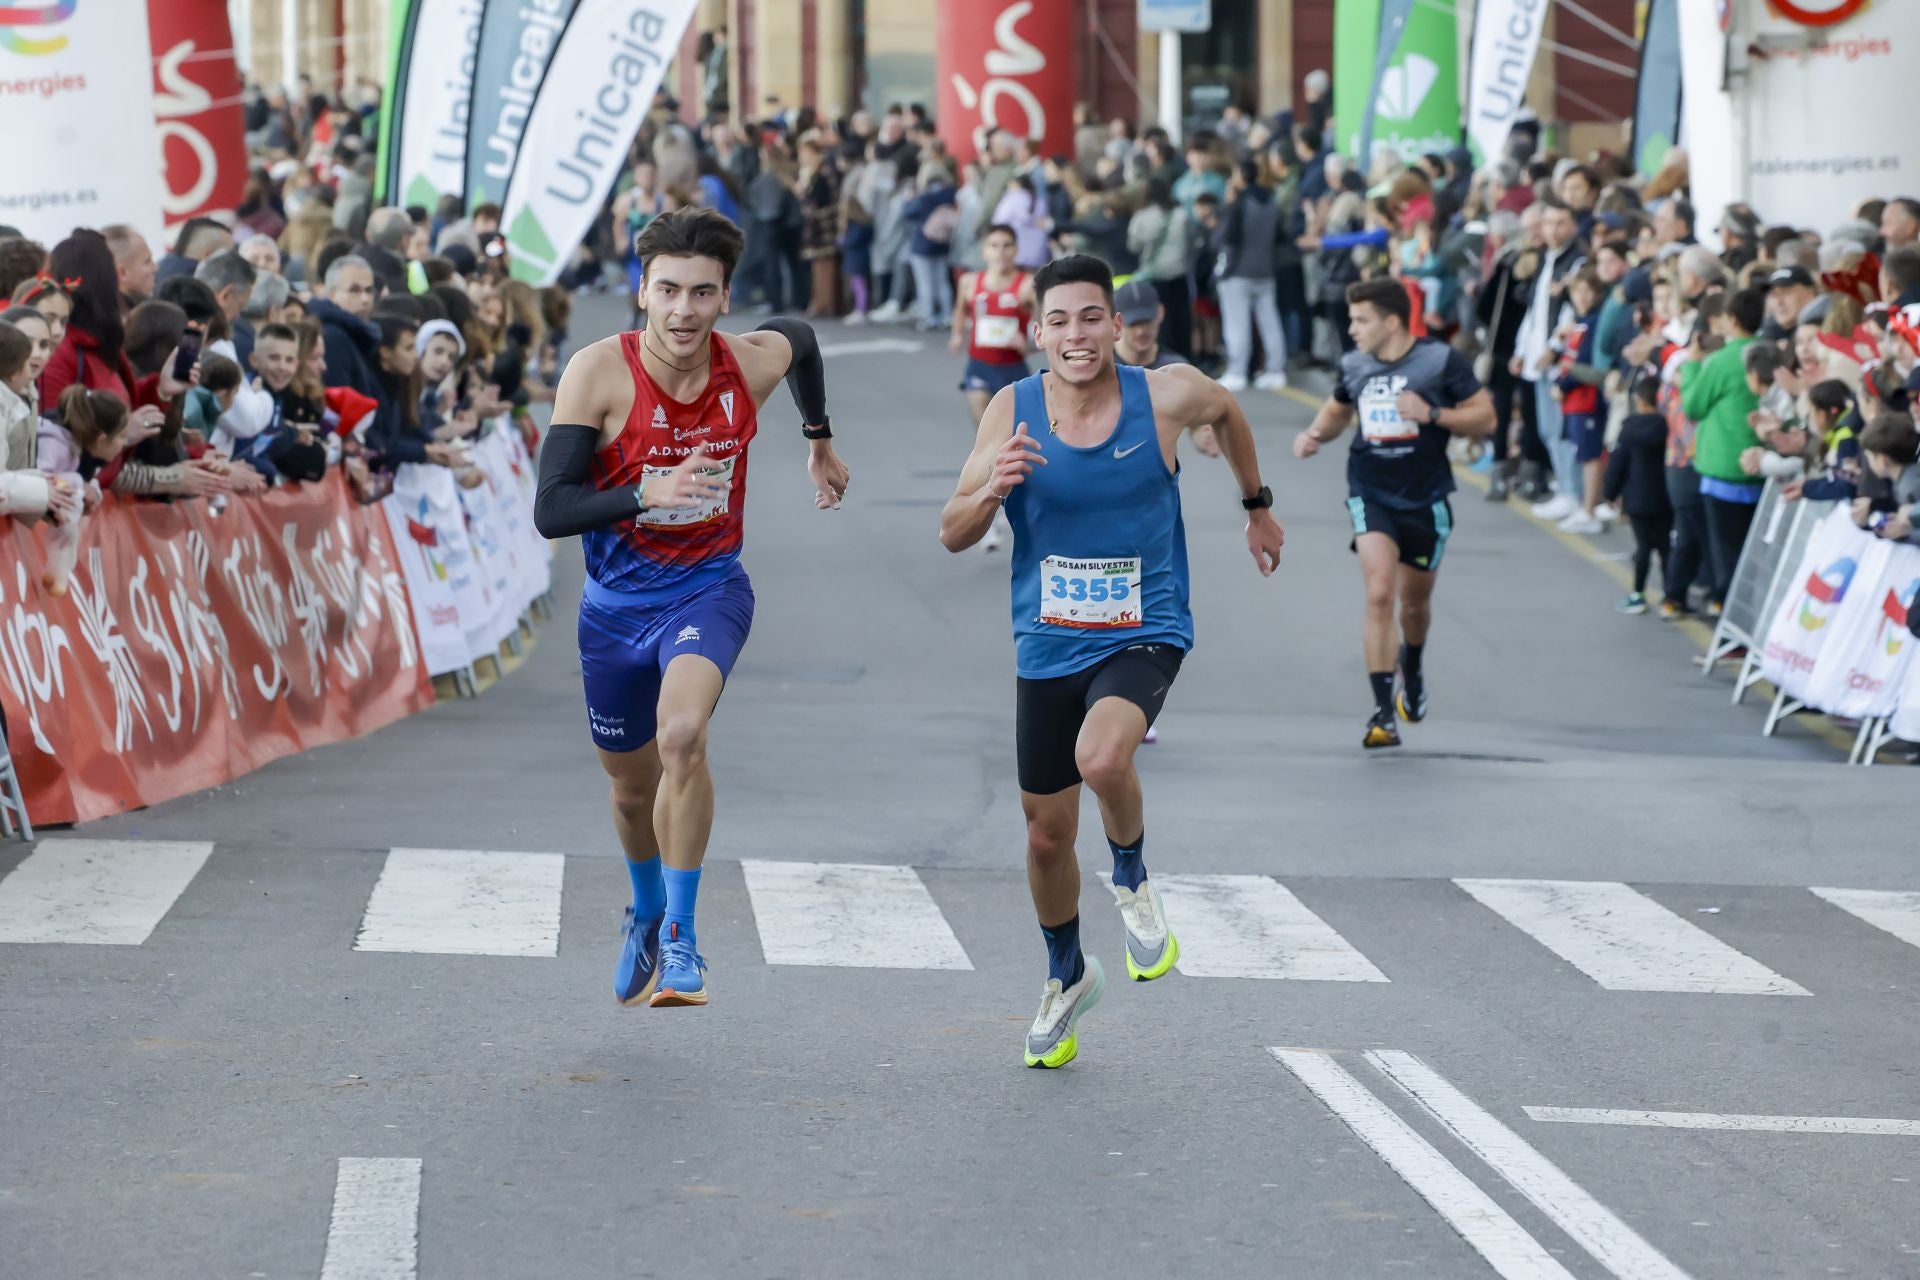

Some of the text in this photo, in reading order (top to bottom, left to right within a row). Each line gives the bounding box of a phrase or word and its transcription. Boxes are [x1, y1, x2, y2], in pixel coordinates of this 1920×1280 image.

[546, 9, 667, 206] Unicaja
[1069, 562, 1087, 570] SAN
[1088, 561, 1135, 570] SILVESTRE
[1051, 575, 1130, 601] 3355
[592, 722, 625, 735] ADM
